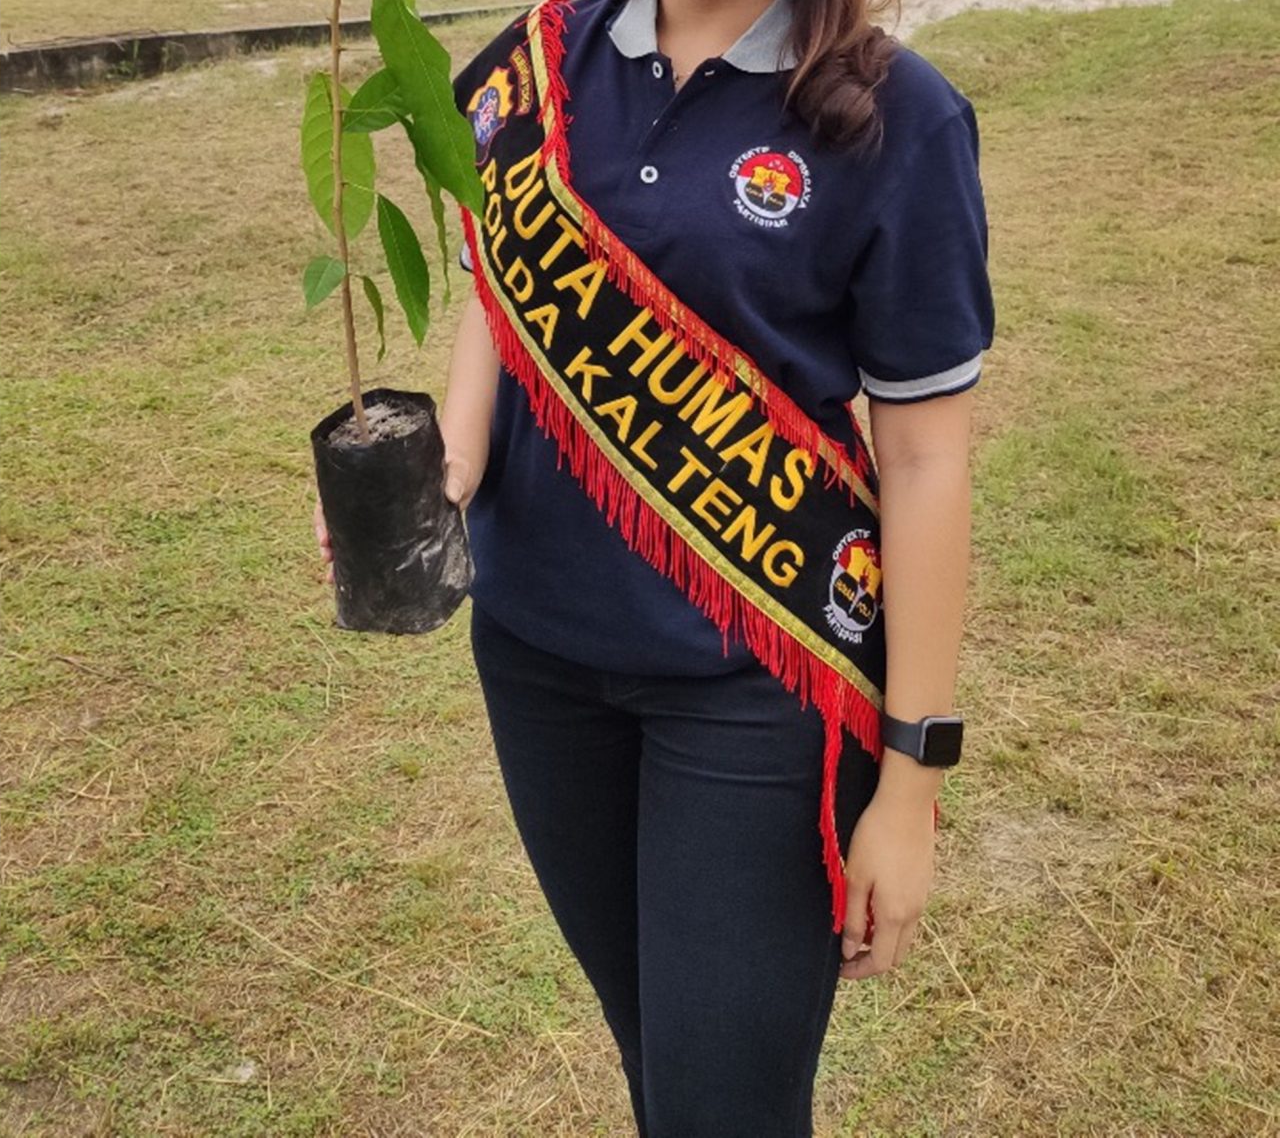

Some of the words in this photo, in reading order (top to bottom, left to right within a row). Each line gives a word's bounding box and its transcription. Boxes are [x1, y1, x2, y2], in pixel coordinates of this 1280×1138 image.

[480, 157, 560, 351] POLDA
[563, 346, 805, 588] KALTENG
[504, 148, 609, 321] DUTA
[606, 306, 814, 512] HUMAS
